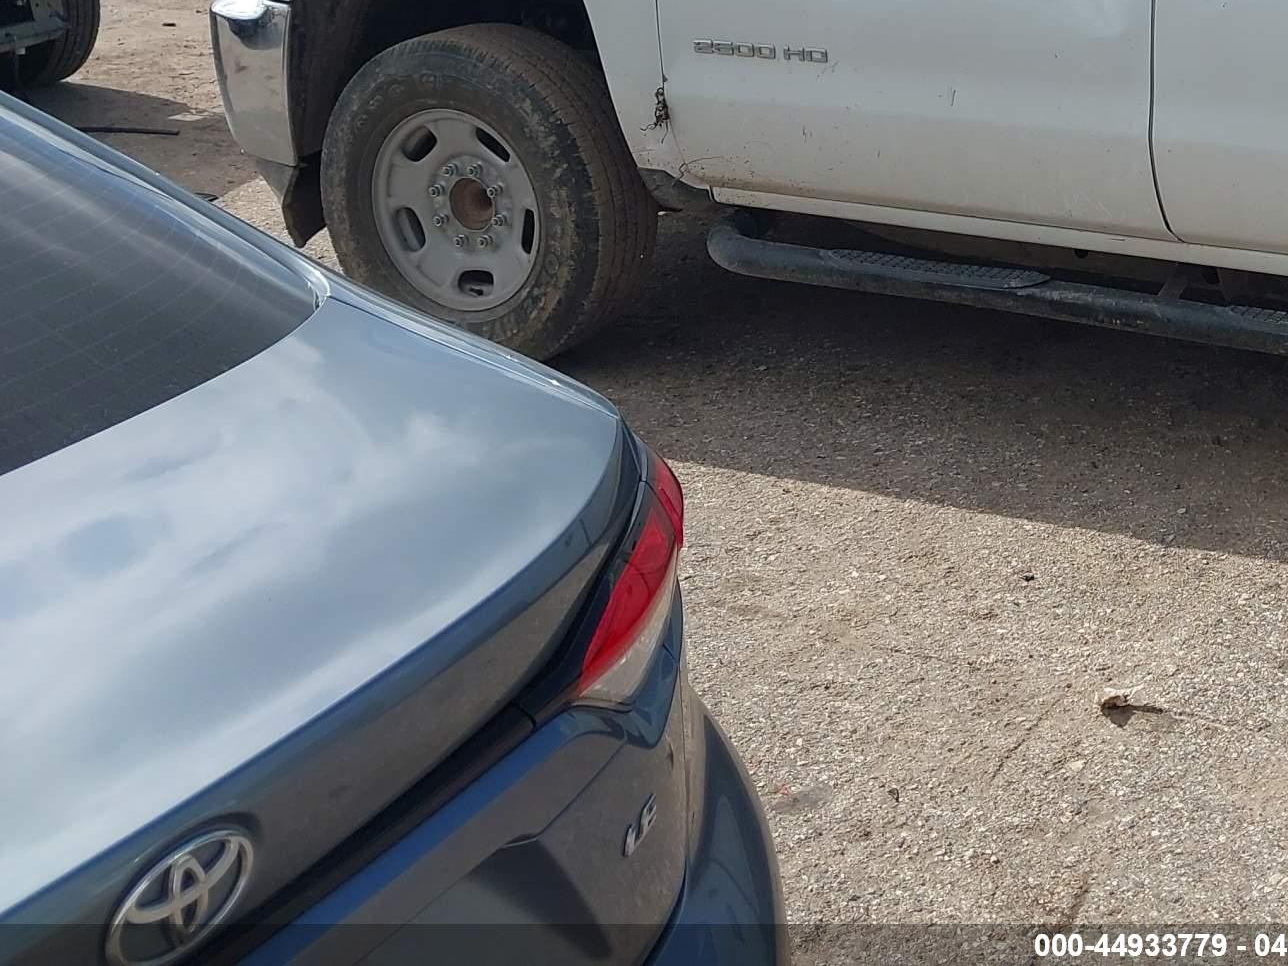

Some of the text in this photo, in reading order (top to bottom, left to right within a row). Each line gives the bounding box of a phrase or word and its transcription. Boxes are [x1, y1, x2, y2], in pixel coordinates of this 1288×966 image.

[693, 38, 828, 63] 2500 HD
[623, 793, 657, 858] LE
